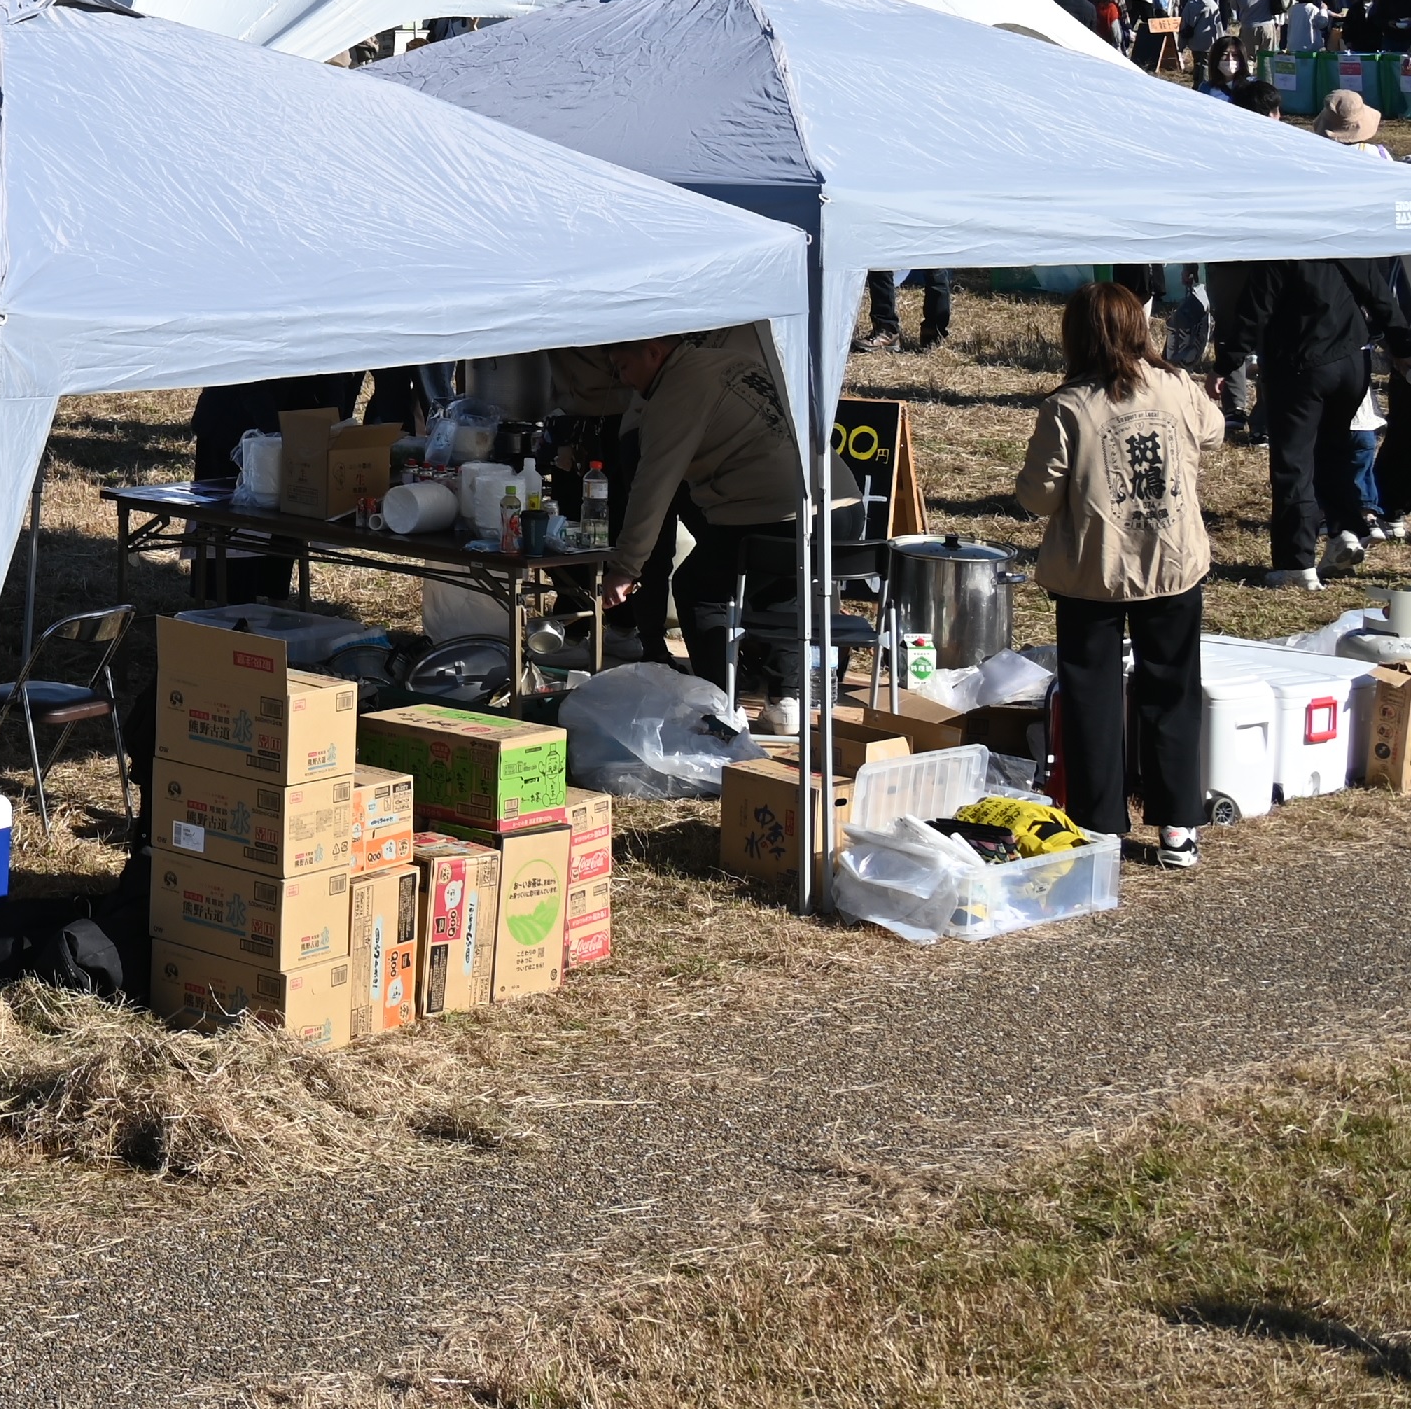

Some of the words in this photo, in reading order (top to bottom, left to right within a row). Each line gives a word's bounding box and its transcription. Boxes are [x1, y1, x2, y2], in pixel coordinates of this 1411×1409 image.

[1125, 431, 1167, 500] 斑鳩
[188, 718, 230, 741] 熊野古道
[232, 709, 253, 742] 水
[186, 809, 228, 832] 熊野古道
[230, 800, 251, 835] 水
[367, 851, 382, 863] Qoo
[182, 900, 224, 923] 熊野古道
[227, 893, 247, 927] 水
[448, 910, 457, 938] Qoo
[390, 950, 399, 978] Qoo
